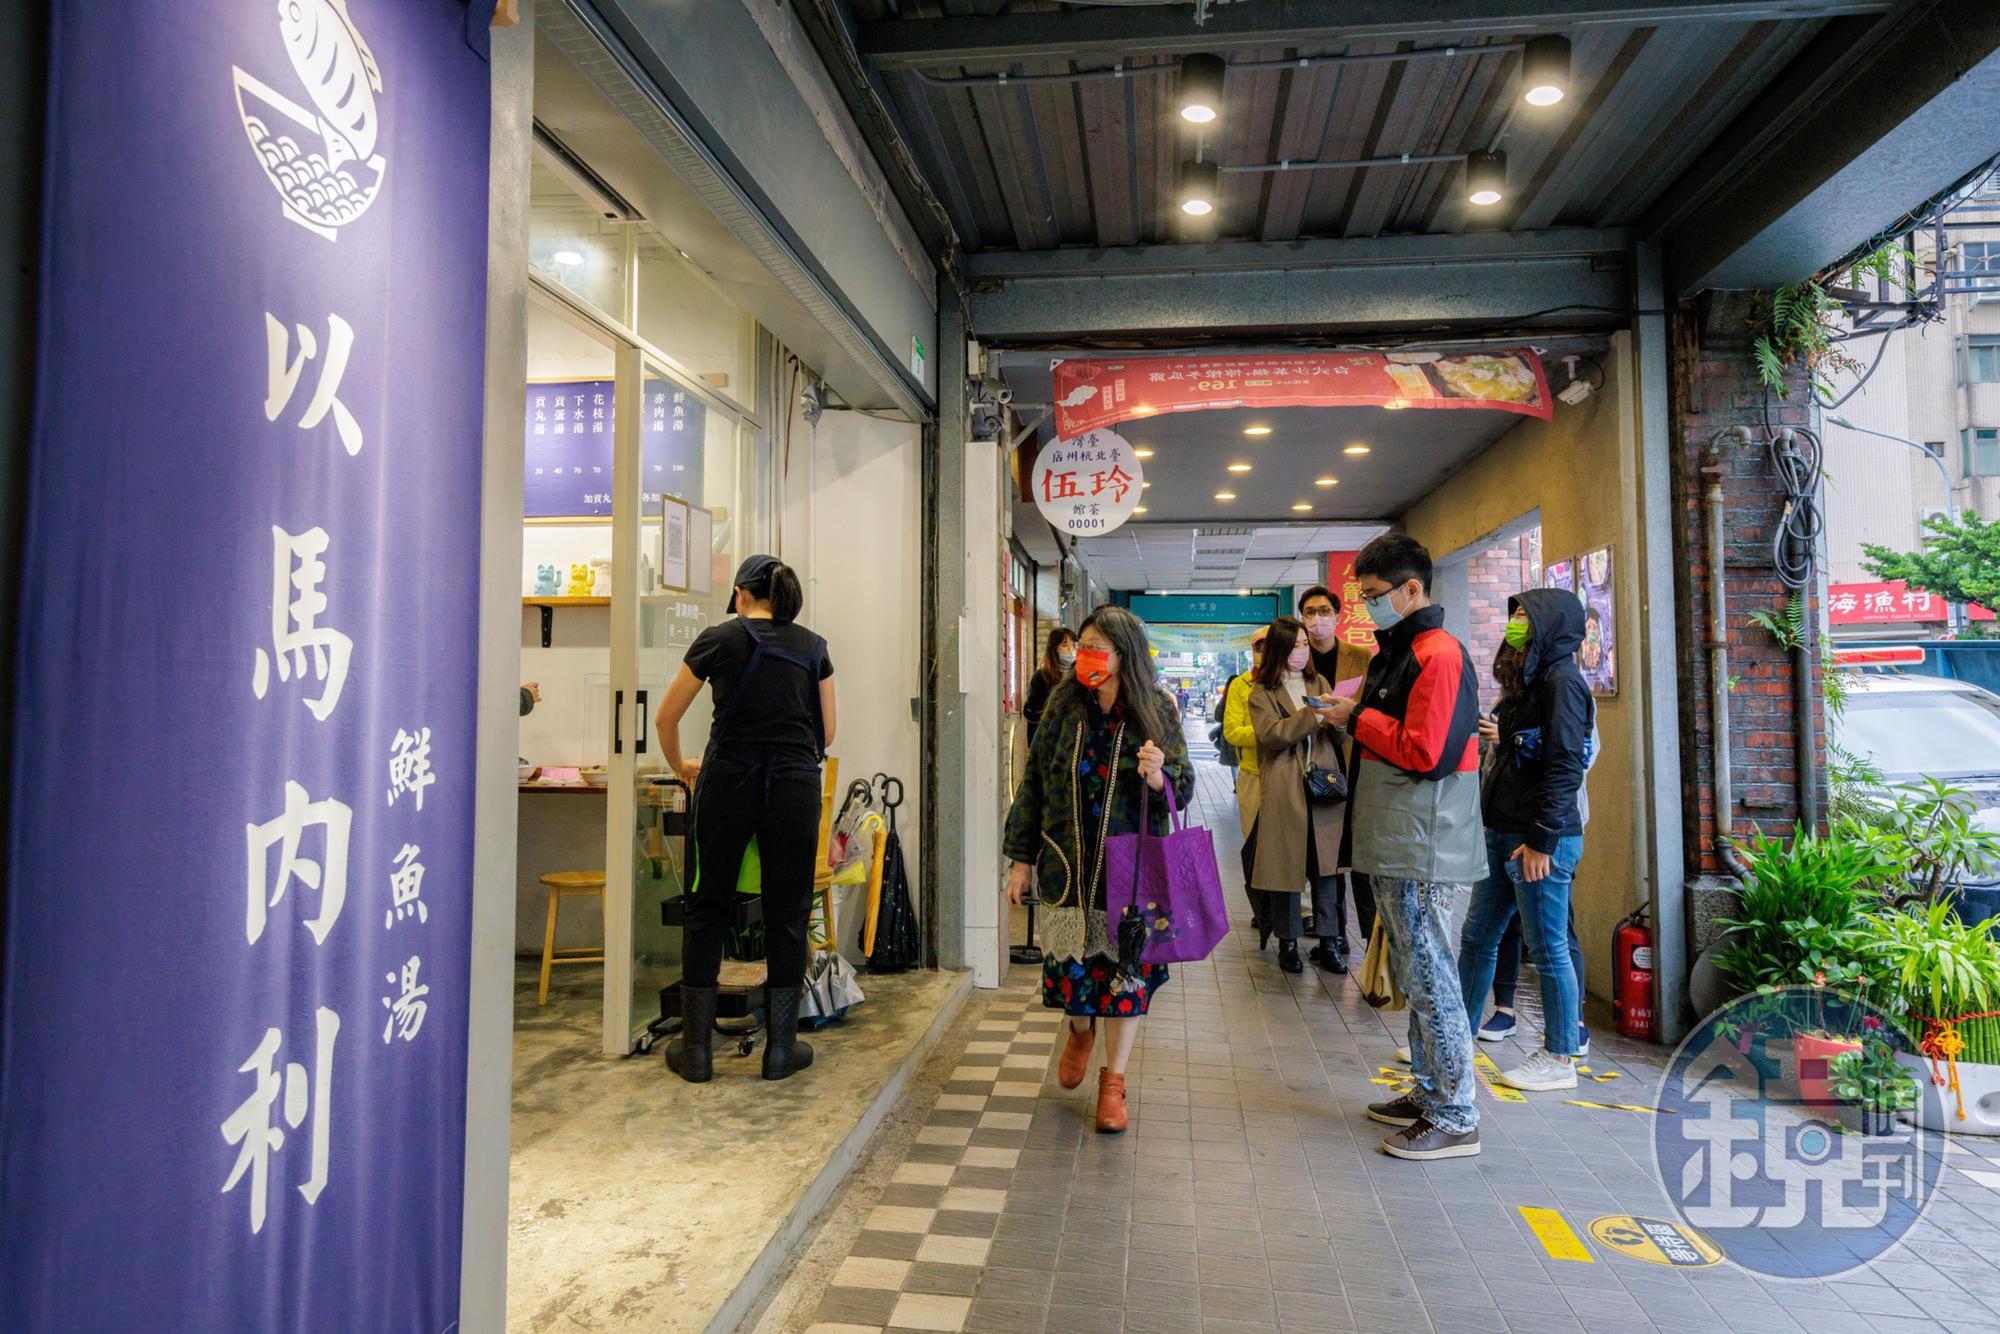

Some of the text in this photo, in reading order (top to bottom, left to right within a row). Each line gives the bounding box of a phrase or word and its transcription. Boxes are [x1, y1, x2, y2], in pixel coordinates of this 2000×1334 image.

[534, 395, 546, 436] 貢丸湯
[573, 394, 585, 435] 下水湯
[592, 392, 605, 434] 花枝湯
[672, 391, 685, 432] 鮮魚湯
[573, 466, 582, 474] 70
[1068, 518, 1105, 529] 00001
[1342, 563, 1377, 646] 籠湯包
[1829, 590, 1930, 614] 海漁村
[220, 311, 363, 1235] 以馬內利
[381, 725, 437, 1045] 鮮魚湯
